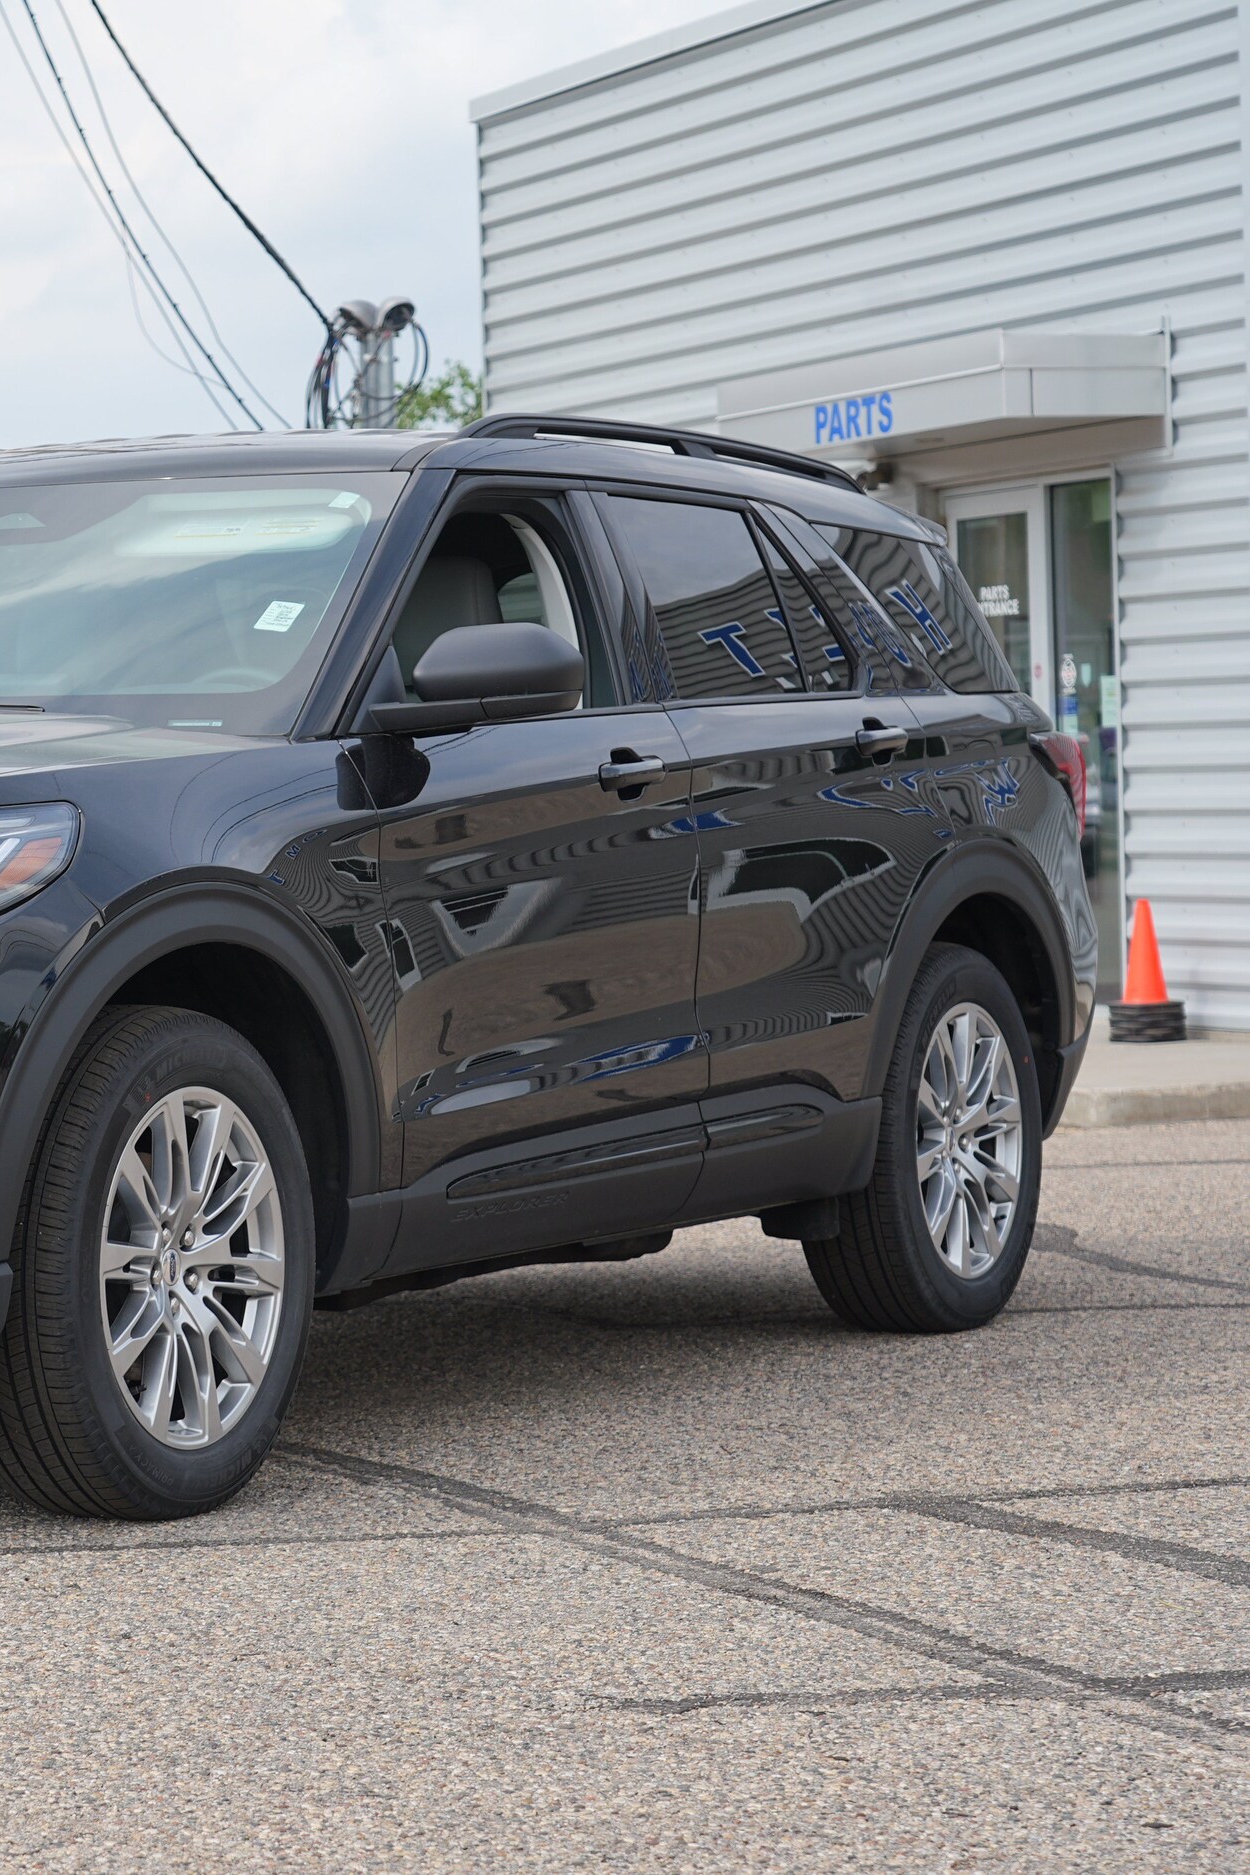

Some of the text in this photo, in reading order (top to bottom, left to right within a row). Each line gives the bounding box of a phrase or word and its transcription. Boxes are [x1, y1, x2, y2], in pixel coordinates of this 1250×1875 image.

[815, 391, 893, 444] PARTS
[980, 585, 1009, 601] PARTS
[977, 599, 1019, 617] NTRANCE
